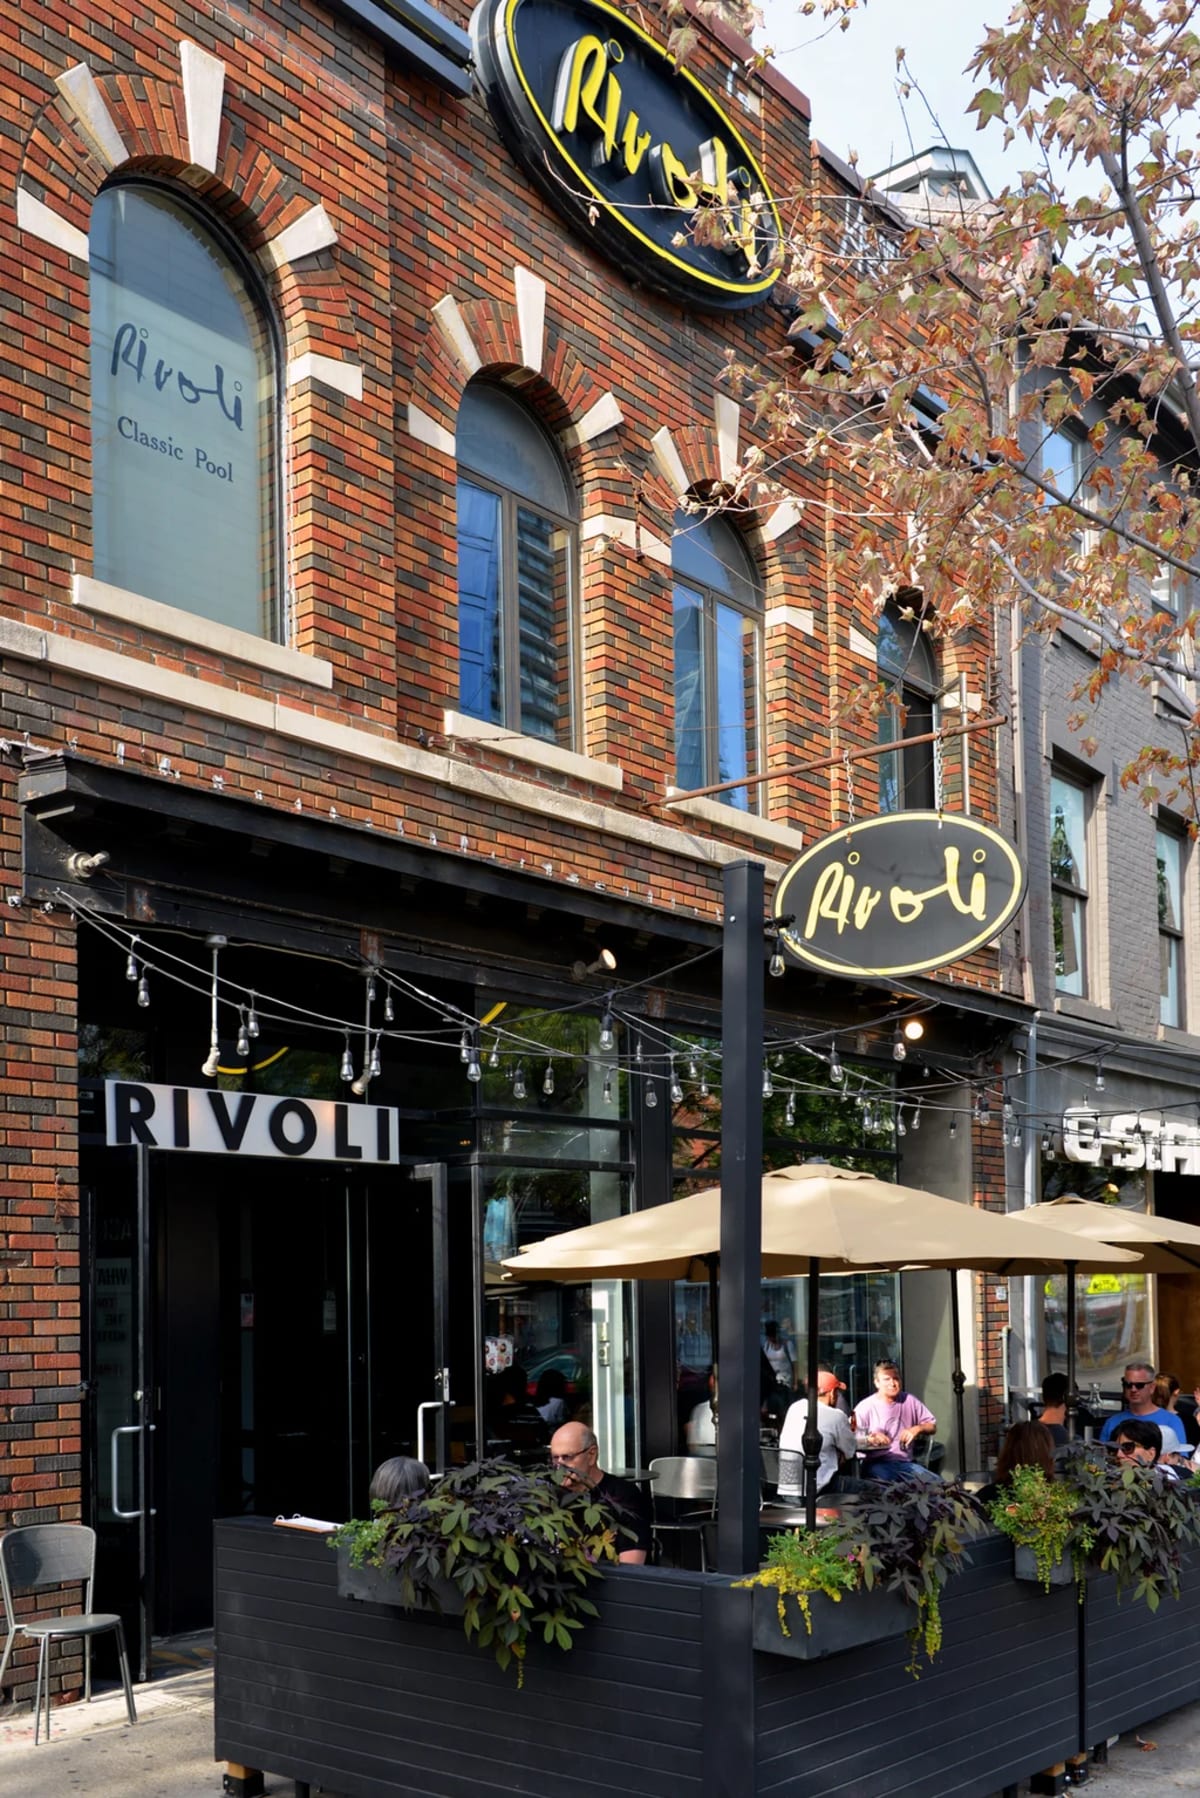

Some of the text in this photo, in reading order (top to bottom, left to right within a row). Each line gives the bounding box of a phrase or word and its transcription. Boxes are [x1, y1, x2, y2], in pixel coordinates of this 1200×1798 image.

[554, 34, 757, 264] Rivoli
[110, 322, 244, 432] Rivoli
[117, 415, 233, 483] Classic Pool
[804, 846, 987, 940] Rivoli
[114, 1082, 391, 1162] RIVOLI
